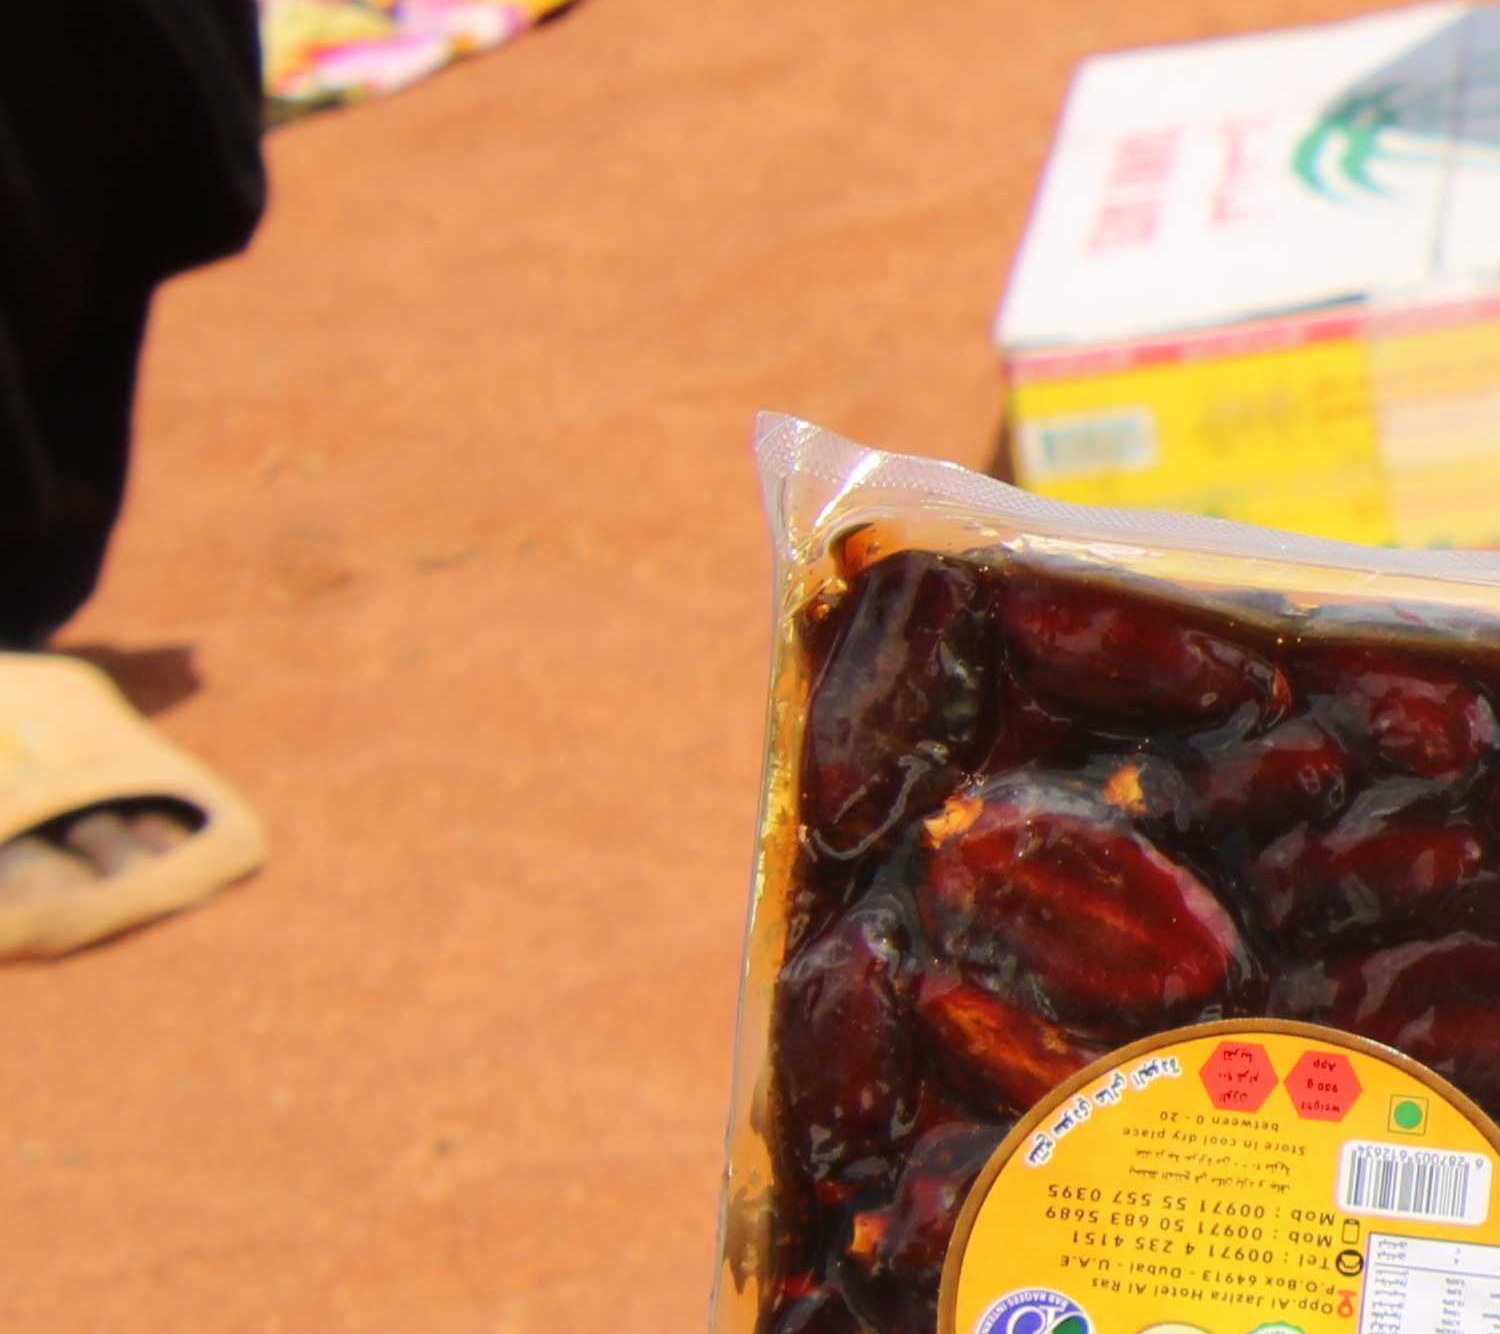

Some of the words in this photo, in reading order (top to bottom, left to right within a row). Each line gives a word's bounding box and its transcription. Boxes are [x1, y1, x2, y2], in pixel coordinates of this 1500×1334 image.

[1159, 1111, 1178, 1122] 20
[1211, 1115, 1279, 1133] between
[1122, 1127, 1166, 1140] place
[1172, 1131, 1197, 1143] dry
[1203, 1135, 1236, 1149] cool
[1264, 1142, 1305, 1155] Store
[1414, 1152, 1464, 1167] 287005
[1475, 1158, 1484, 1169] 6
[1048, 1184, 1101, 1202] 0395
[1113, 1191, 1151, 1207] 557
[1163, 1196, 1187, 1211] 55
[1200, 1199, 1264, 1219] 00971
[1046, 1206, 1099, 1223] 5689
[1110, 1212, 1149, 1227] 683
[1291, 1210, 1335, 1226] Mob
[1160, 1217, 1184, 1232] 50
[1197, 1221, 1262, 1241] 00971
[1073, 1231, 1124, 1247] 4151
[1136, 1237, 1173, 1253] 235
[1289, 1231, 1333, 1248] Mob
[1185, 1243, 1194, 1255] 4
[1208, 1245, 1273, 1264] 00971
[1060, 1255, 1110, 1270] U.A.E
[1299, 1254, 1329, 1269] Tel
[1130, 1263, 1182, 1279] Dubai
[1202, 1270, 1257, 1285] 64913
[1092, 1278, 1120, 1292] Ras
[1128, 1283, 1147, 1295] Al
[1154, 1286, 1203, 1300] Hotel
[1211, 1292, 1264, 1307] Jazira
